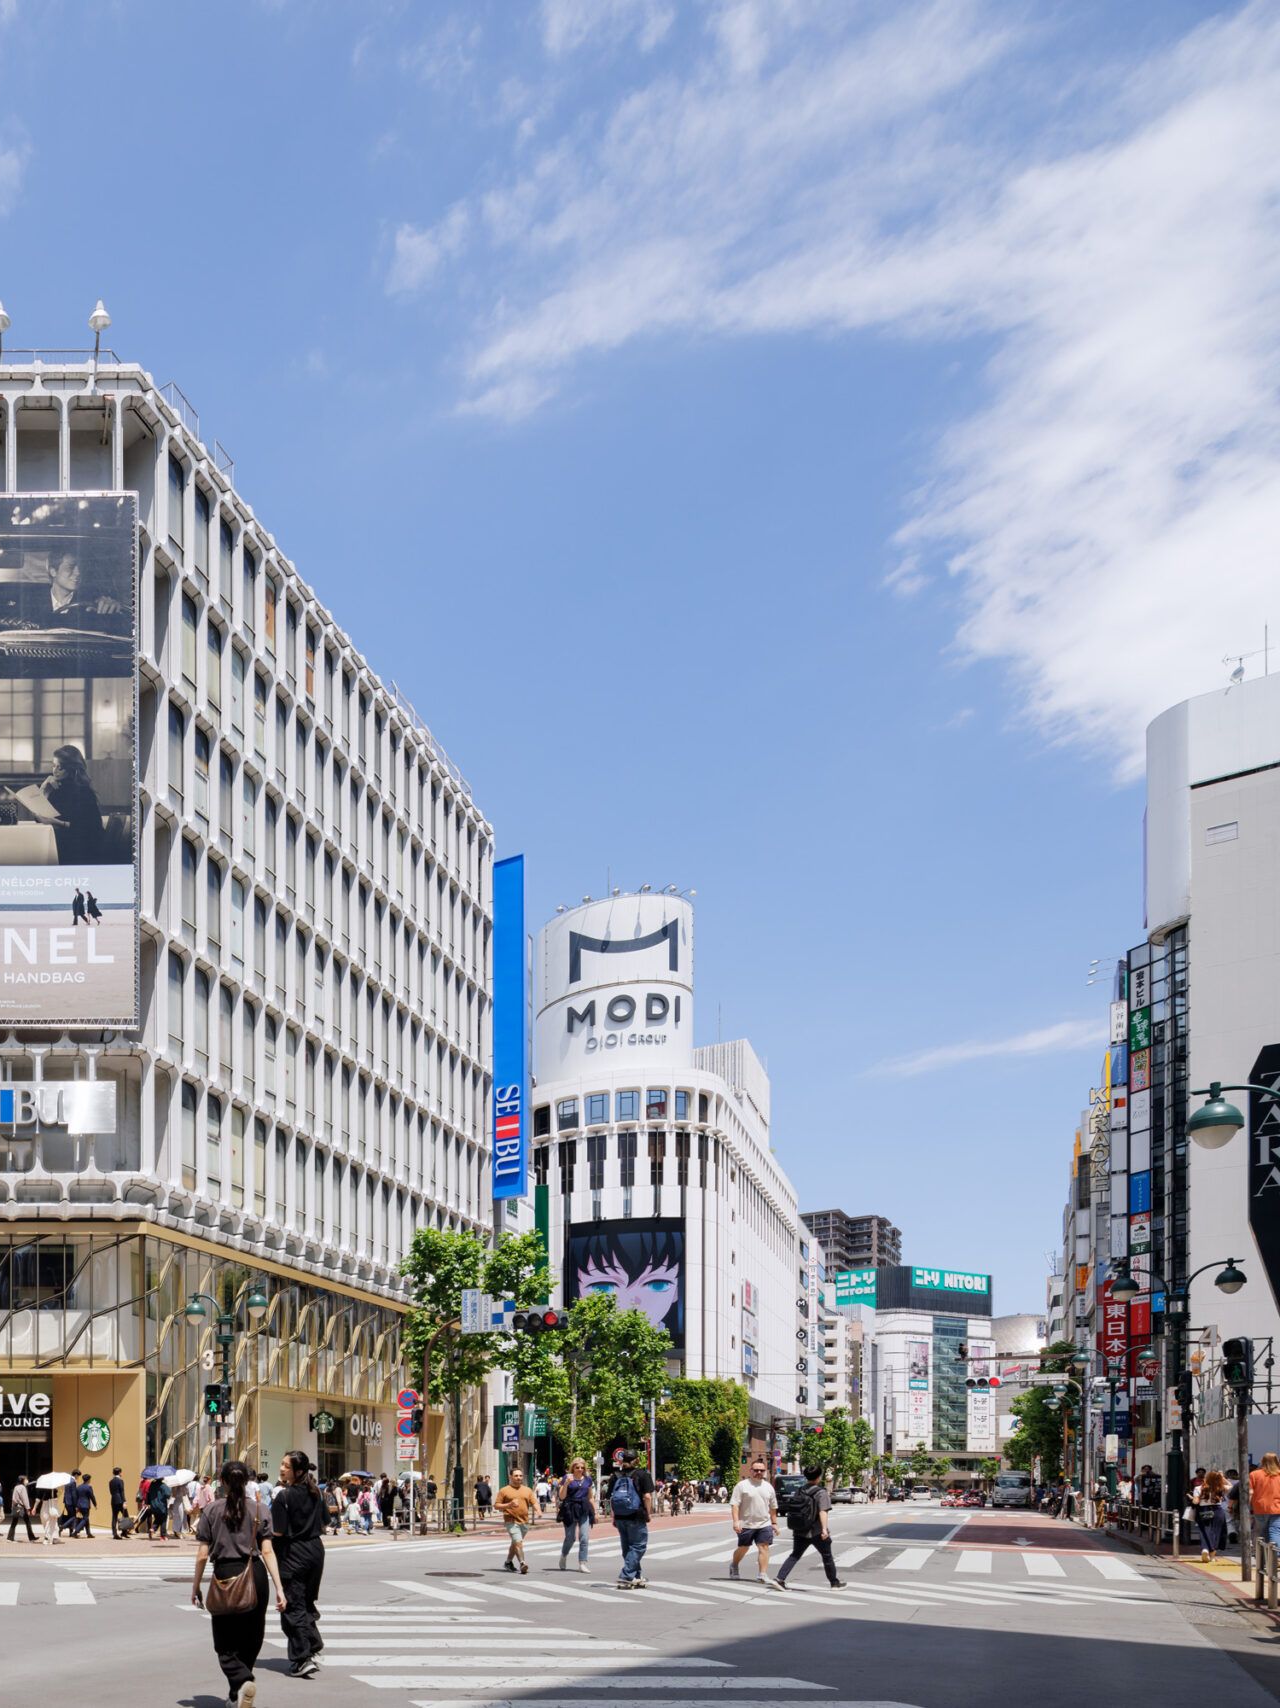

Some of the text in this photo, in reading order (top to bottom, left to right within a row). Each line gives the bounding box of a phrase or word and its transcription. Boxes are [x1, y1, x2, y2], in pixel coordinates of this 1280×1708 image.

[54, 877, 89, 887] CRUZ
[4, 972, 86, 984] HANDBAG
[567, 993, 681, 1033] MODI
[628, 1034, 667, 1046] GROUP
[496, 1084, 520, 1179] SEIBU
[1089, 1087, 1110, 1192] KARAOKE
[837, 1271, 876, 1288] ニトリ
[915, 1269, 987, 1292] ニトリ NITORI
[836, 1285, 875, 1297] NITORI
[1199, 1325, 1220, 1347] 4
[202, 1349, 214, 1371] 3
[350, 1413, 382, 1438] Olive
[503, 1427, 516, 1442] P
